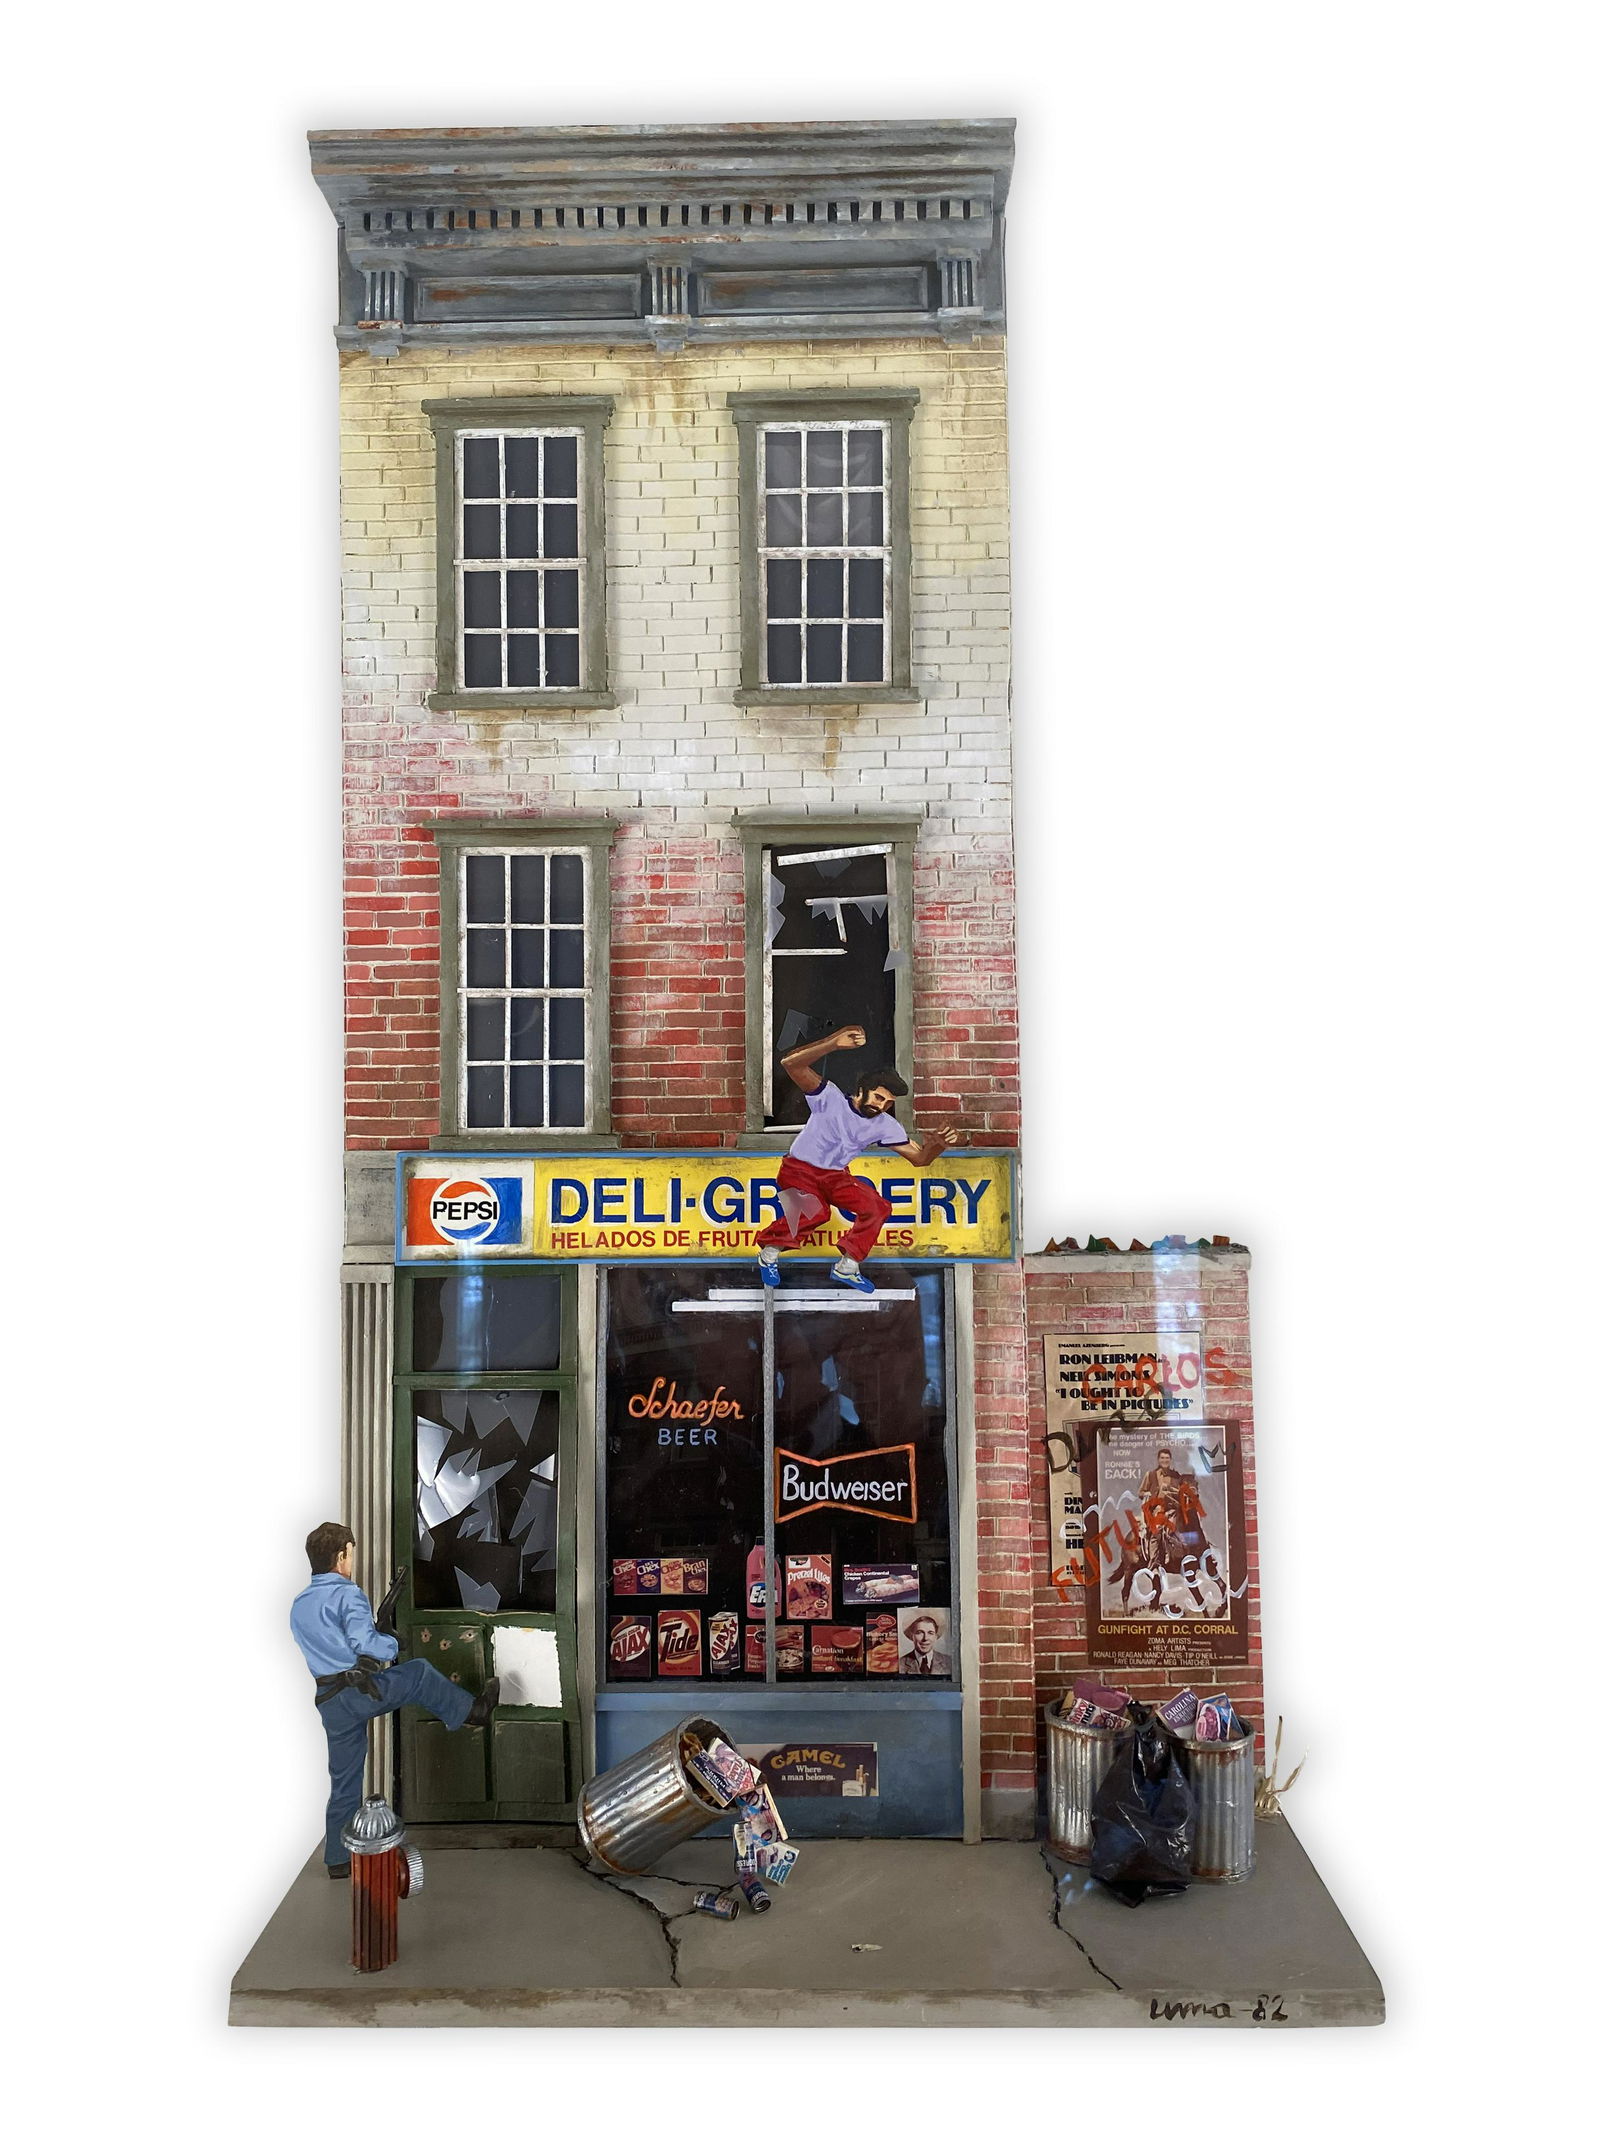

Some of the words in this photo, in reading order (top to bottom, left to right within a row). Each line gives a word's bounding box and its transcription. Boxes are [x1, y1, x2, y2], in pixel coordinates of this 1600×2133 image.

[431, 1200, 498, 1221] PEPSI
[552, 1231, 656, 1249] HELADOS
[663, 1231, 690, 1247] DE
[1059, 1354, 1092, 1364] RON
[1081, 1347, 1252, 1404] CARLOS
[628, 1376, 744, 1426] Schaefer
[1081, 1401, 1098, 1410] BE
[1101, 1400, 1117, 1410] IN
[657, 1427, 718, 1446] BEER
[1119, 1433, 1148, 1441] mystery
[1149, 1432, 1158, 1440] of
[1160, 1432, 1176, 1440] THE
[1120, 1440, 1144, 1448] danger
[1146, 1439, 1154, 1447] of
[782, 1463, 908, 1501] Budweiser
[1105, 1468, 1141, 1479] BACK!
[1052, 1482, 1207, 1603] FUTURA
[637, 1562, 660, 1575] Chex
[1098, 1625, 1152, 1634] GUNFIGHT
[1155, 1625, 1169, 1634] AT
[1172, 1625, 1192, 1634] D.C.
[1194, 1625, 1239, 1634] CORRAL
[613, 1627, 649, 1663] AJAX
[660, 1623, 699, 1663] Tide
[711, 1623, 730, 1659] AJAX
[1167, 1637, 1191, 1645] ARTISTS
[1164, 1693, 1196, 1720] CAROLINA
[770, 1749, 846, 1769] CAMEL
[796, 1765, 822, 1773] Where
